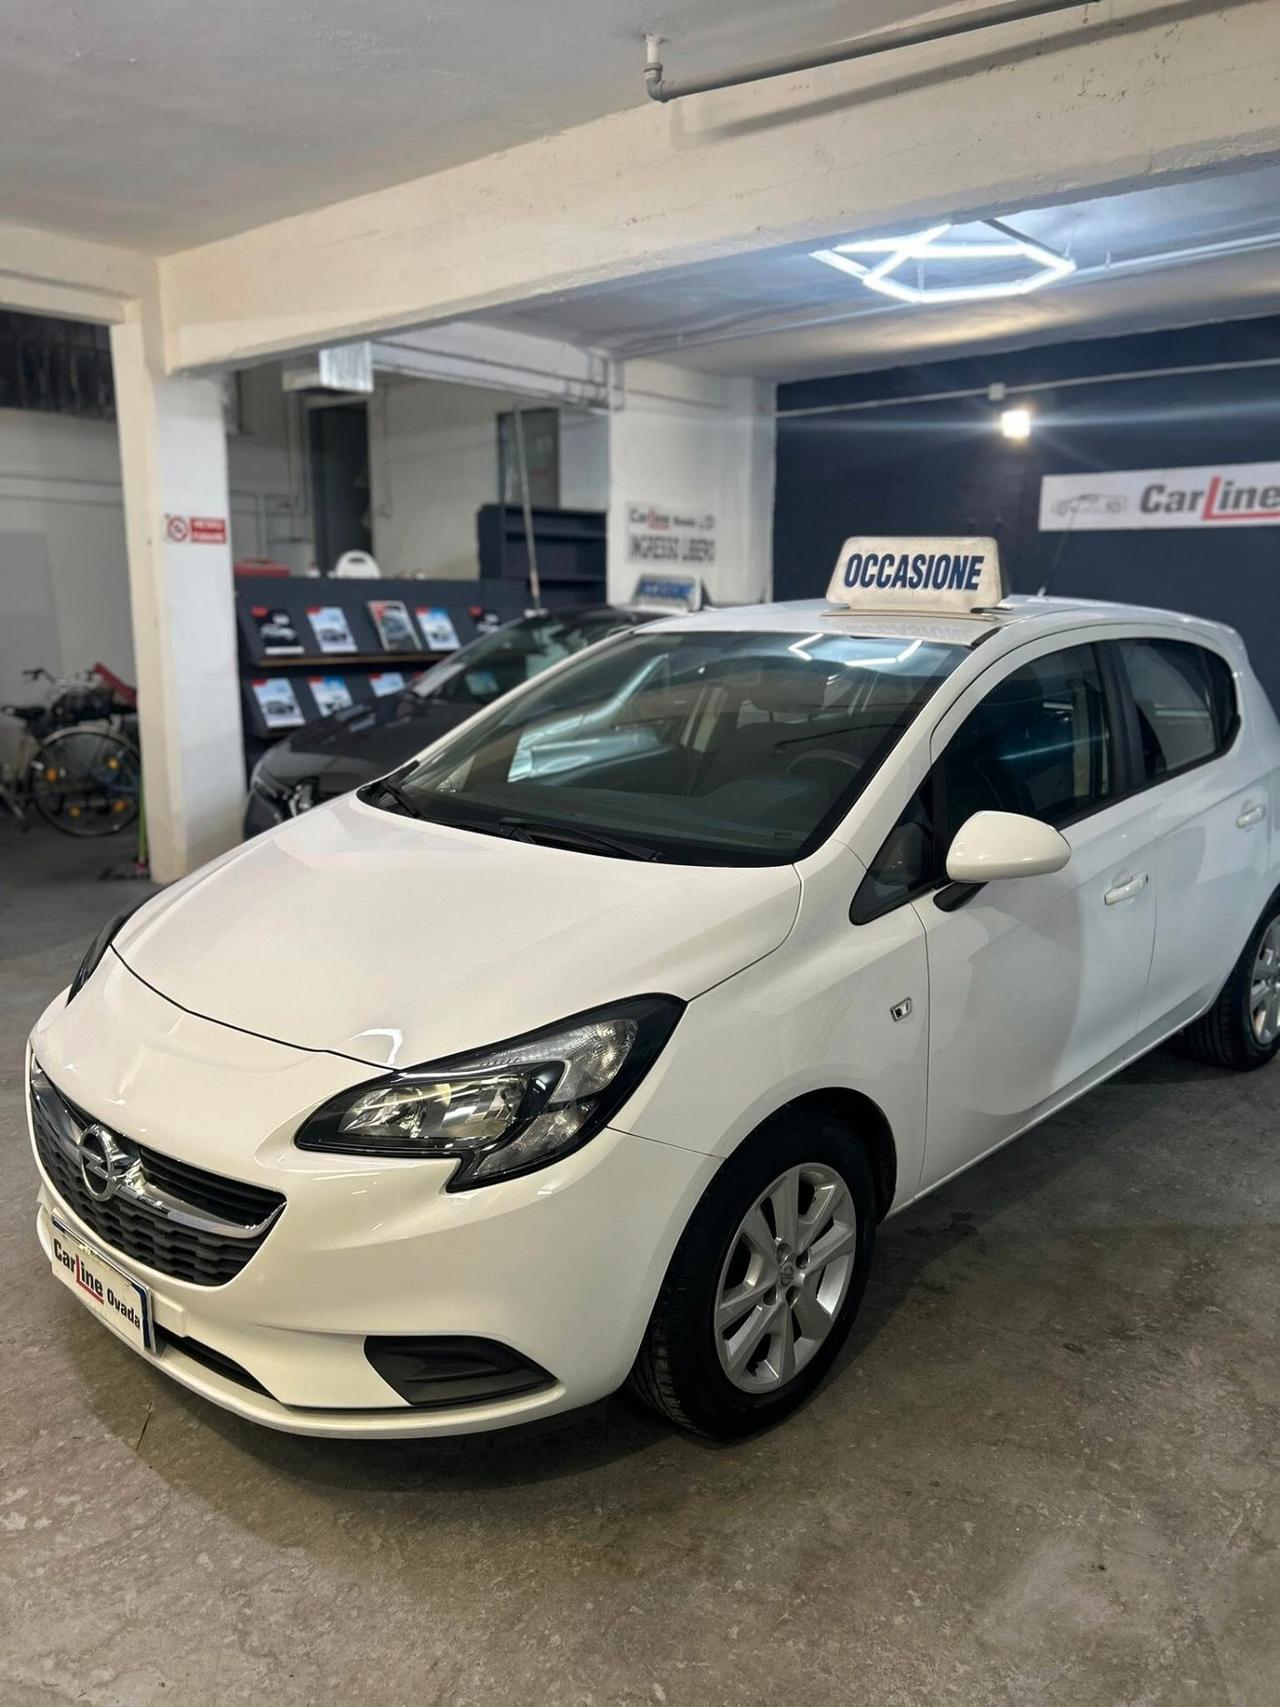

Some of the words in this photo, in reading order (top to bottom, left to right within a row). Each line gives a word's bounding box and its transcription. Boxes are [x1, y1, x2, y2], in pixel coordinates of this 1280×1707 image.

[1139, 475, 1280, 520] CarLine
[844, 553, 985, 590] OCCASIONE
[53, 1238, 104, 1305] CarLine
[106, 1288, 141, 1329] Ovada
